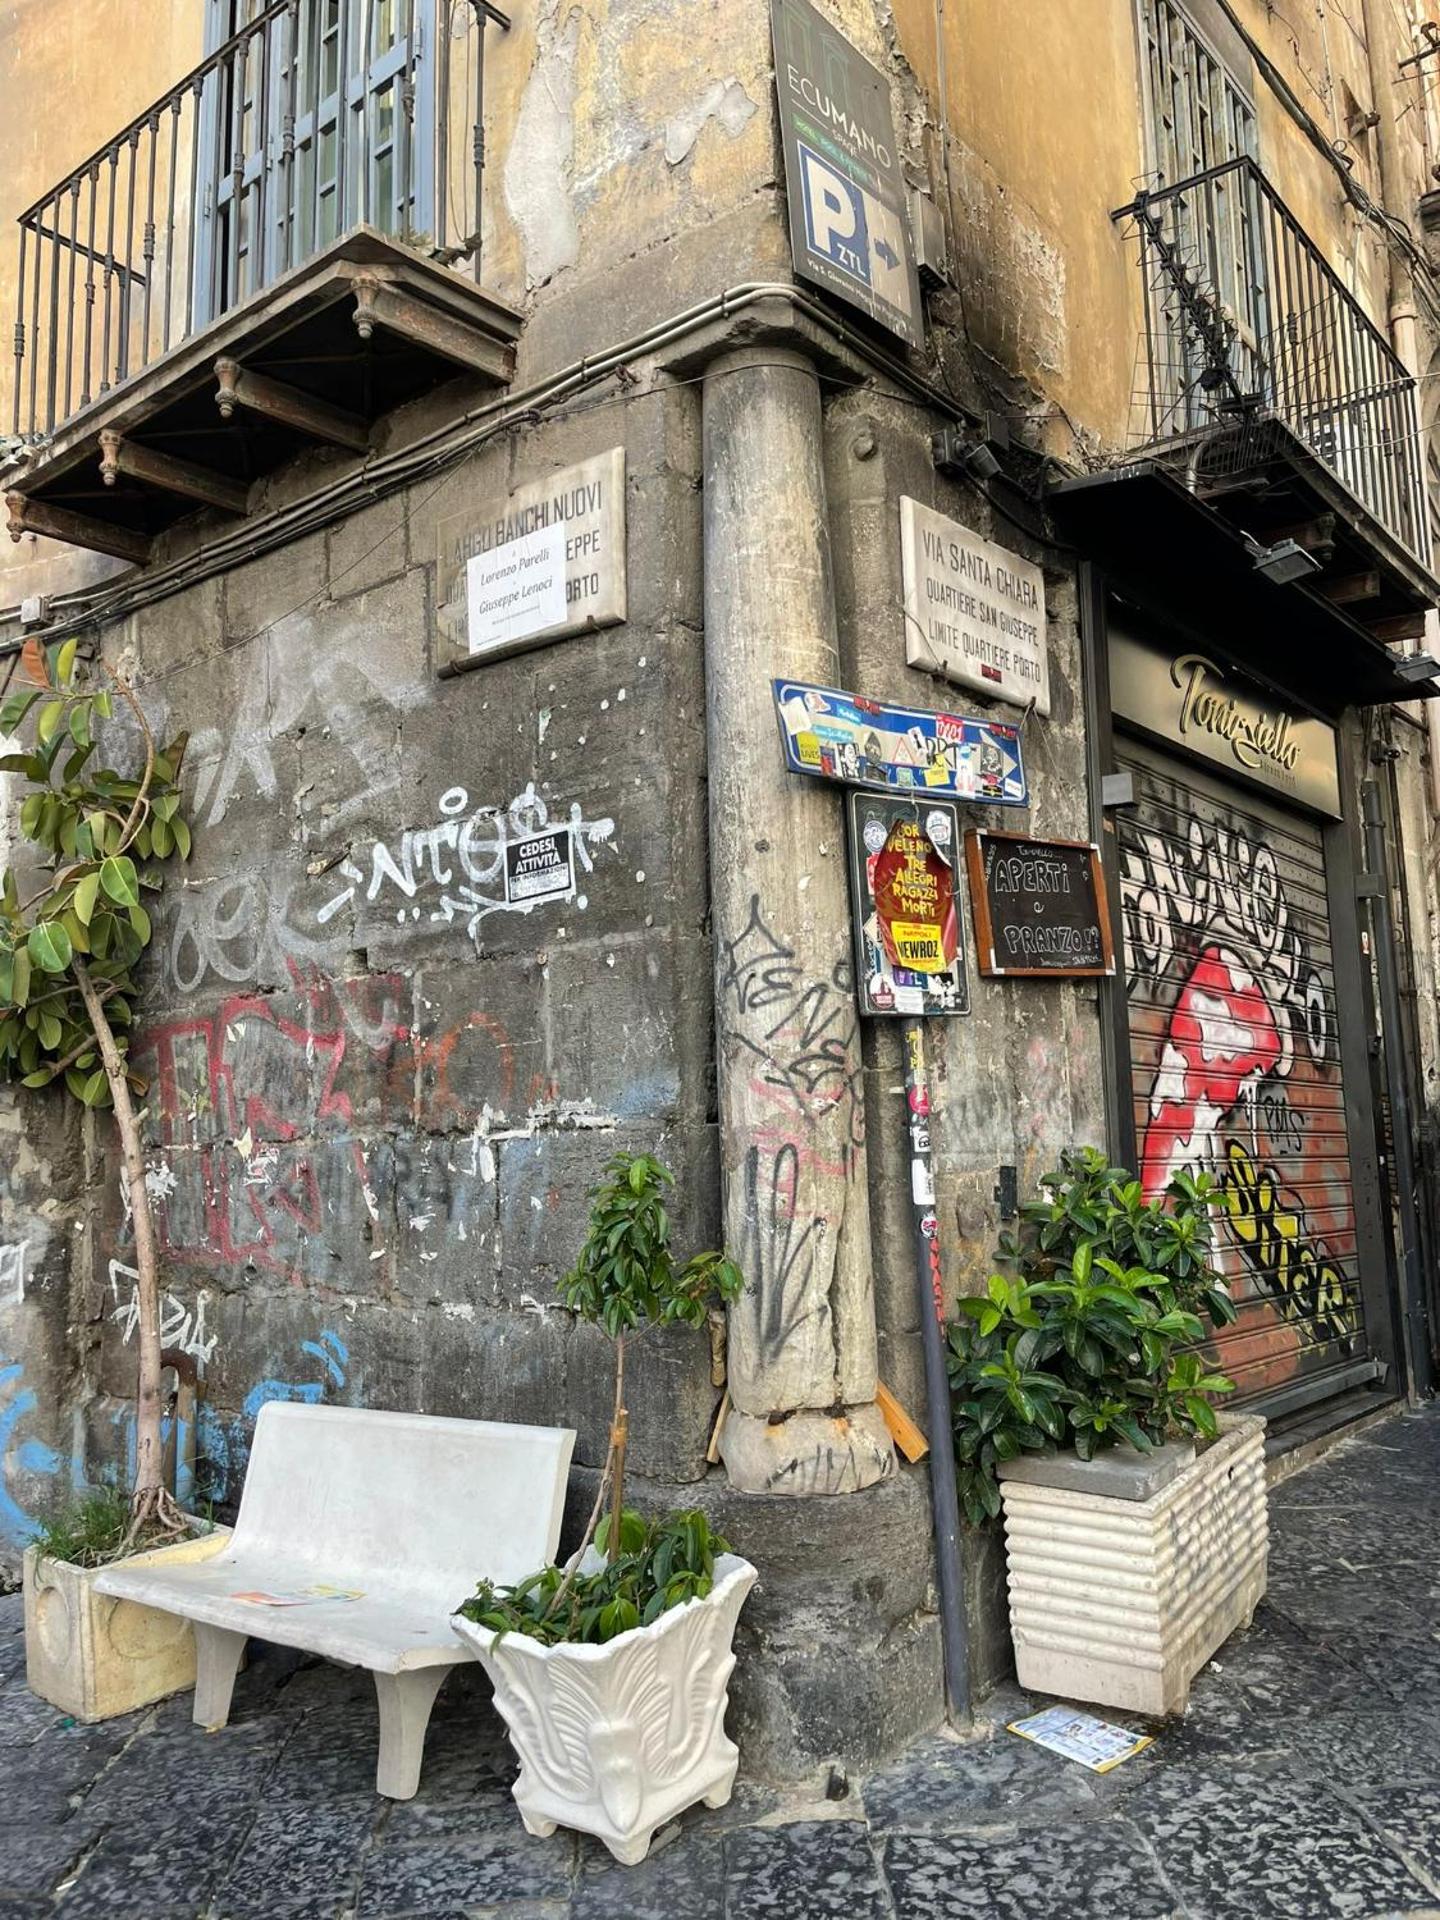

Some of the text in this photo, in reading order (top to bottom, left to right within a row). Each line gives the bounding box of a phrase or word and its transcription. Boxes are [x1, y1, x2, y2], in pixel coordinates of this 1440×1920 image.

[788, 63, 891, 168] ECUMANO
[806, 154, 856, 254] P
[836, 243, 867, 277] ZTL
[496, 500, 549, 548] BANCHI
[554, 480, 602, 524] NUOVI
[565, 529, 601, 562] EPPE
[481, 564, 517, 586] Lorenzo
[519, 548, 549, 571] Parelli
[922, 529, 1039, 611] VIA SANTA CHIARA
[479, 591, 520, 615] Giuseppe
[521, 576, 553, 597] Lenoci
[565, 572, 599, 604] ORTO
[926, 577, 1039, 647] QUARTIERE SAN GIUSEPPE
[928, 618, 959, 649] LIMITE
[962, 632, 1011, 671] QUARTIERE
[1013, 653, 1041, 683] PORTO
[519, 836, 556, 858] CEDESI
[887, 835, 933, 853] VELENO
[896, 823, 920, 838] COR
[895, 867, 938, 887] ALLEGRI
[903, 854, 927, 872] TRE
[892, 882, 938, 901] RAGAZZI
